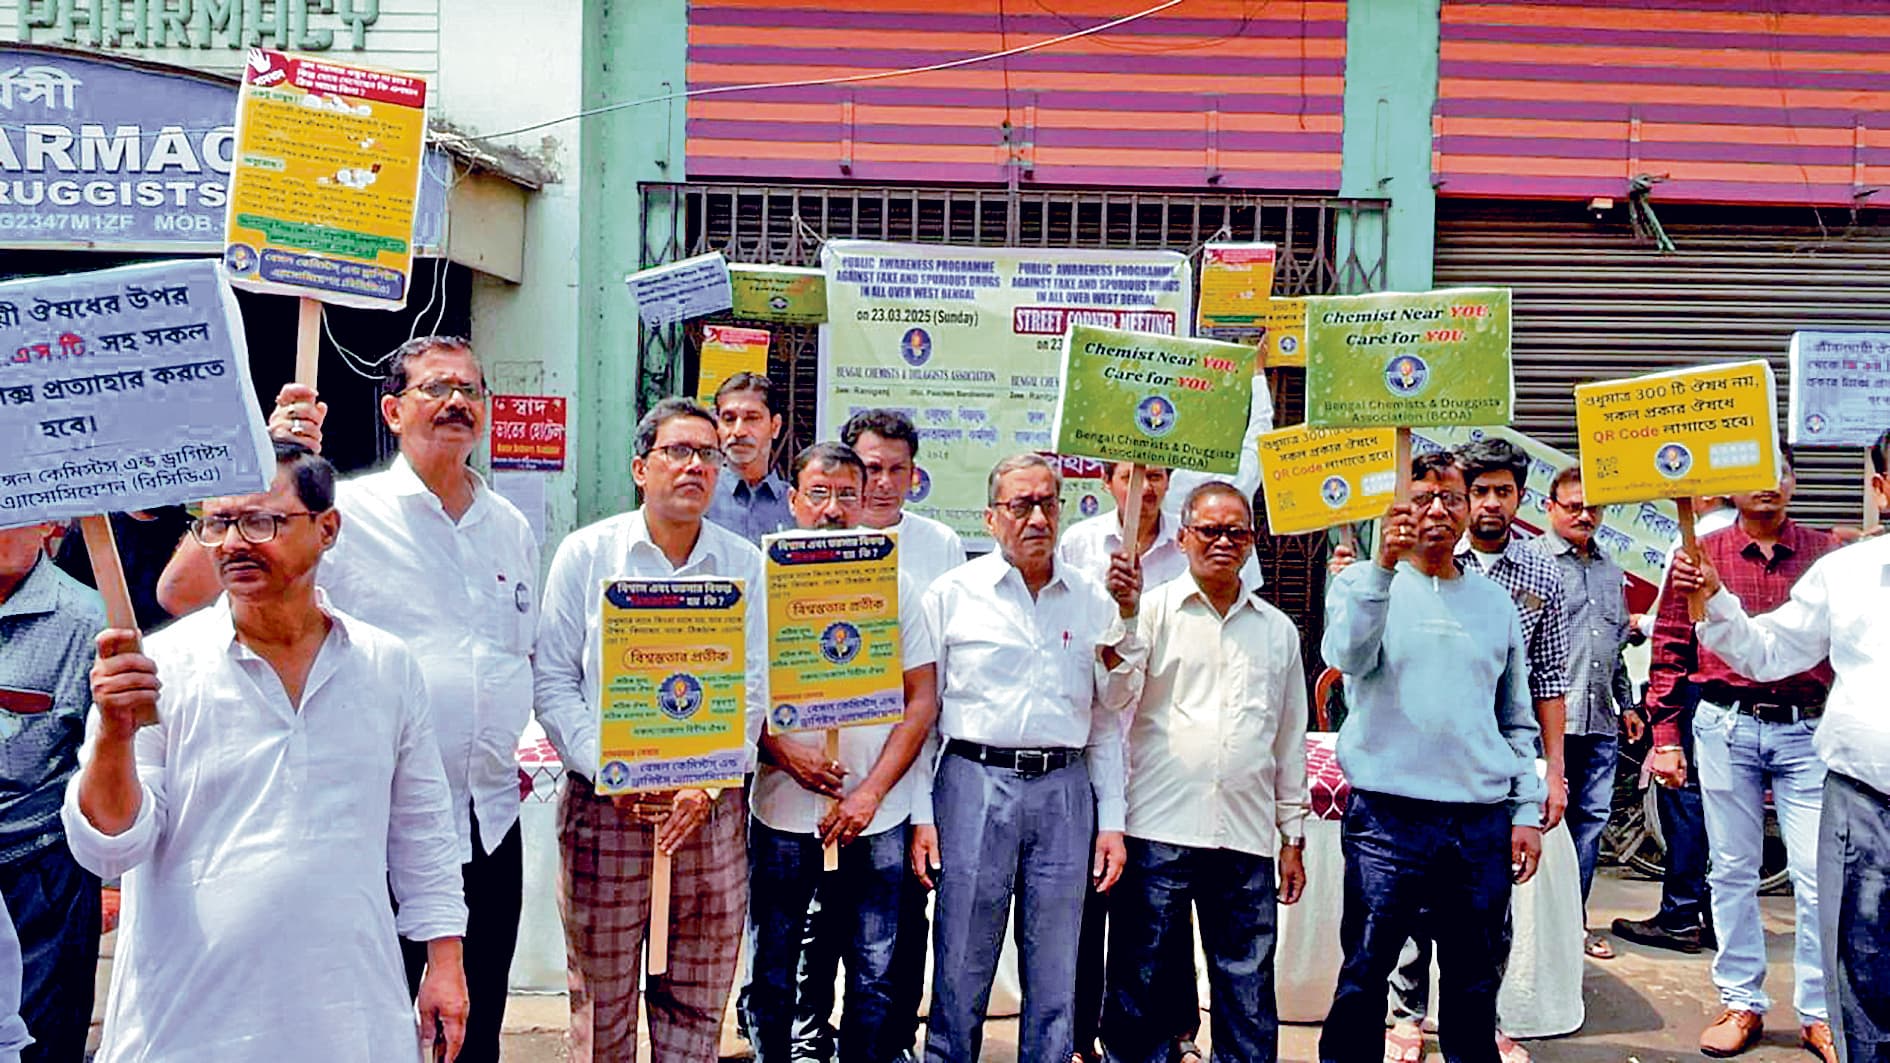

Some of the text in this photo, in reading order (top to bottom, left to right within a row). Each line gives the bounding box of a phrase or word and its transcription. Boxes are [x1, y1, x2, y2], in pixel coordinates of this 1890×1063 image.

[0, 125, 235, 173] RMAC
[841, 257, 995, 273] PUBLIC AWARENESS PROGRAMME
[1018, 263, 1052, 274] PUBLIC
[1056, 264, 1113, 276] AWARENESS
[836, 271, 1001, 288] AGAINST FAKE AND SPURIOUS DRUGS
[1012, 276, 1051, 288] AGAINST
[1053, 277, 1076, 289] FAKE
[1078, 278, 1098, 290] AND
[1099, 279, 1147, 291] SPURIOUS
[860, 286, 975, 300] IN ALL OVER WEST BENGAL
[1036, 292, 1156, 305] IN ALL OVER WEST BENGAL
[28, 295, 120, 322] ঔষধের
[126, 286, 189, 310] উপর
[857, 309, 979, 326] on 23.03.2025 (Sunday)
[1016, 309, 1063, 332] STREET
[1119, 313, 1173, 335] MEETING
[1322, 304, 1493, 324] Chemist Near YOU.
[99, 333, 139, 352] সহ
[142, 322, 209, 347] সকল
[1050, 339, 1063, 351] 23
[1345, 330, 1468, 346] Care for YOU.
[1084, 342, 1239, 374] Chemist Near YOU.
[43, 370, 145, 401] প্রত্যাহার
[152, 359, 225, 385] করতে
[1104, 367, 1215, 393] Care for YOU.
[1635, 387, 1666, 401] 300
[1672, 380, 1686, 396] টি
[1324, 399, 1501, 416] Bengal Chemists & Druggists
[1603, 410, 1640, 422] সকল
[1644, 405, 1686, 419] প্রকার
[1352, 410, 1472, 423] Association (BCDA)
[40, 415, 98, 439] হবে।
[1593, 431, 1615, 444] QR
[1619, 426, 1659, 440] Code
[1663, 420, 1717, 435] লাগাতে
[1075, 429, 1114, 446] Bengal
[1117, 433, 1169, 451] Chemists
[1183, 443, 1236, 460] Druggists
[1099, 445, 1165, 463] Association
[1273, 468, 1290, 480] QR
[1291, 464, 1323, 476] Code
